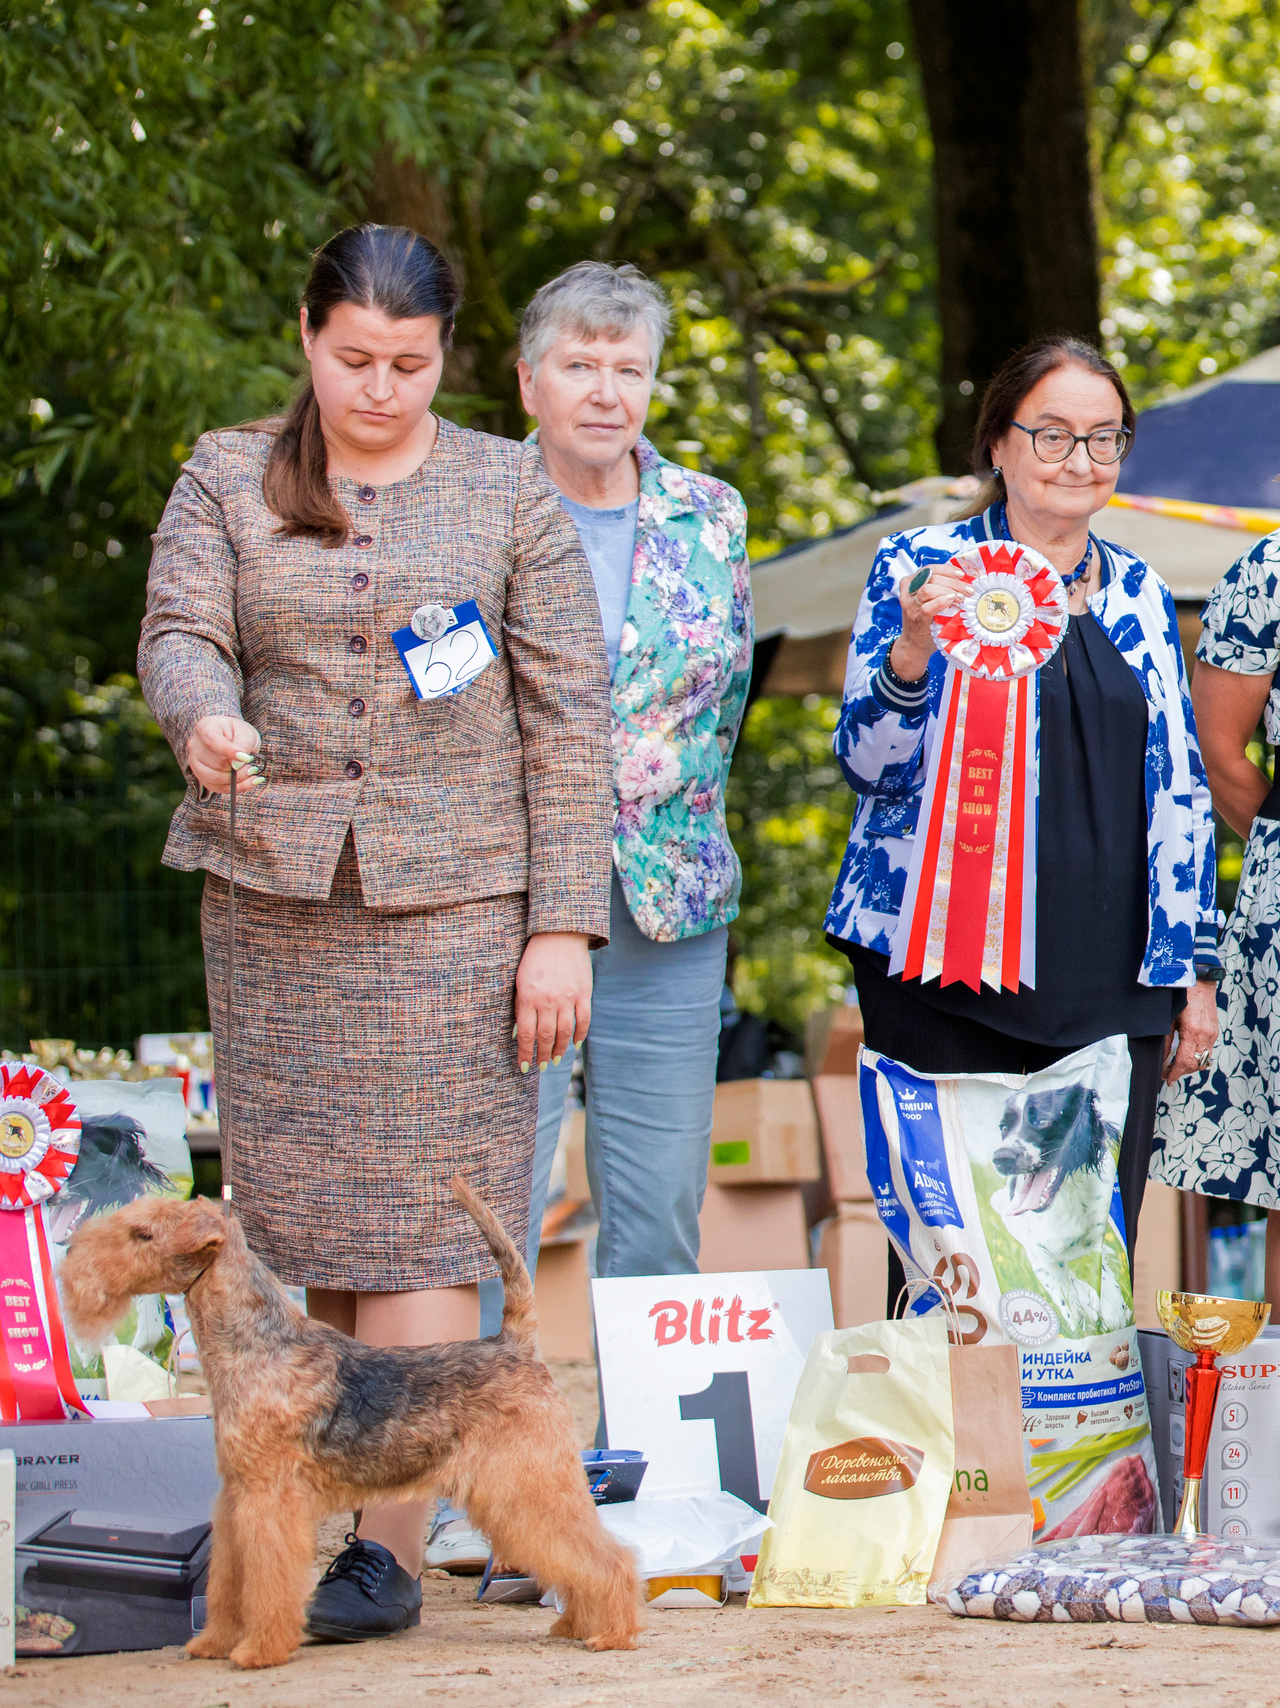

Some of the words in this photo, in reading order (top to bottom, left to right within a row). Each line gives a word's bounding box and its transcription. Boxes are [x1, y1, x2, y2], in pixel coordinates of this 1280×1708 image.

[425, 630, 487, 692] 52
[968, 766, 994, 780] BEST
[973, 785, 985, 797] IN
[962, 801, 993, 816] SHOW
[973, 823, 979, 835] I
[914, 1171, 948, 1195] ADULT
[4, 1295, 30, 1307] BEST
[14, 1312, 27, 1323] IN
[648, 1294, 776, 1347] Blitz
[1012, 1309, 1048, 1326] 44%
[7, 1327, 39, 1338] SHOW
[22, 1344, 33, 1355] II
[1022, 1349, 1092, 1366] ИНДЕЙКА
[1022, 1368, 1033, 1380] И
[1037, 1368, 1075, 1380] УТКА
[1220, 1381, 1246, 1391] Kitchen
[1248, 1380, 1271, 1391] Series
[1037, 1391, 1076, 1402] Комплекс
[1077, 1386, 1117, 1402] пробиотиков
[1044, 1413, 1071, 1421] Здоровая
[1091, 1409, 1110, 1418] Высокая
[1229, 1409, 1235, 1422] 5
[679, 1371, 770, 1516] 1
[1229, 1447, 1240, 1459] 24
[16, 1454, 80, 1466] BRAYER
[821, 1452, 908, 1474] Деревенские
[820, 1466, 902, 1485] лакомства
[950, 1468, 989, 1495] na
[30, 1480, 52, 1491] GRILL
[54, 1479, 79, 1490] PRESS
[1227, 1487, 1239, 1500] 11
[1228, 1525, 1240, 1534] LED
